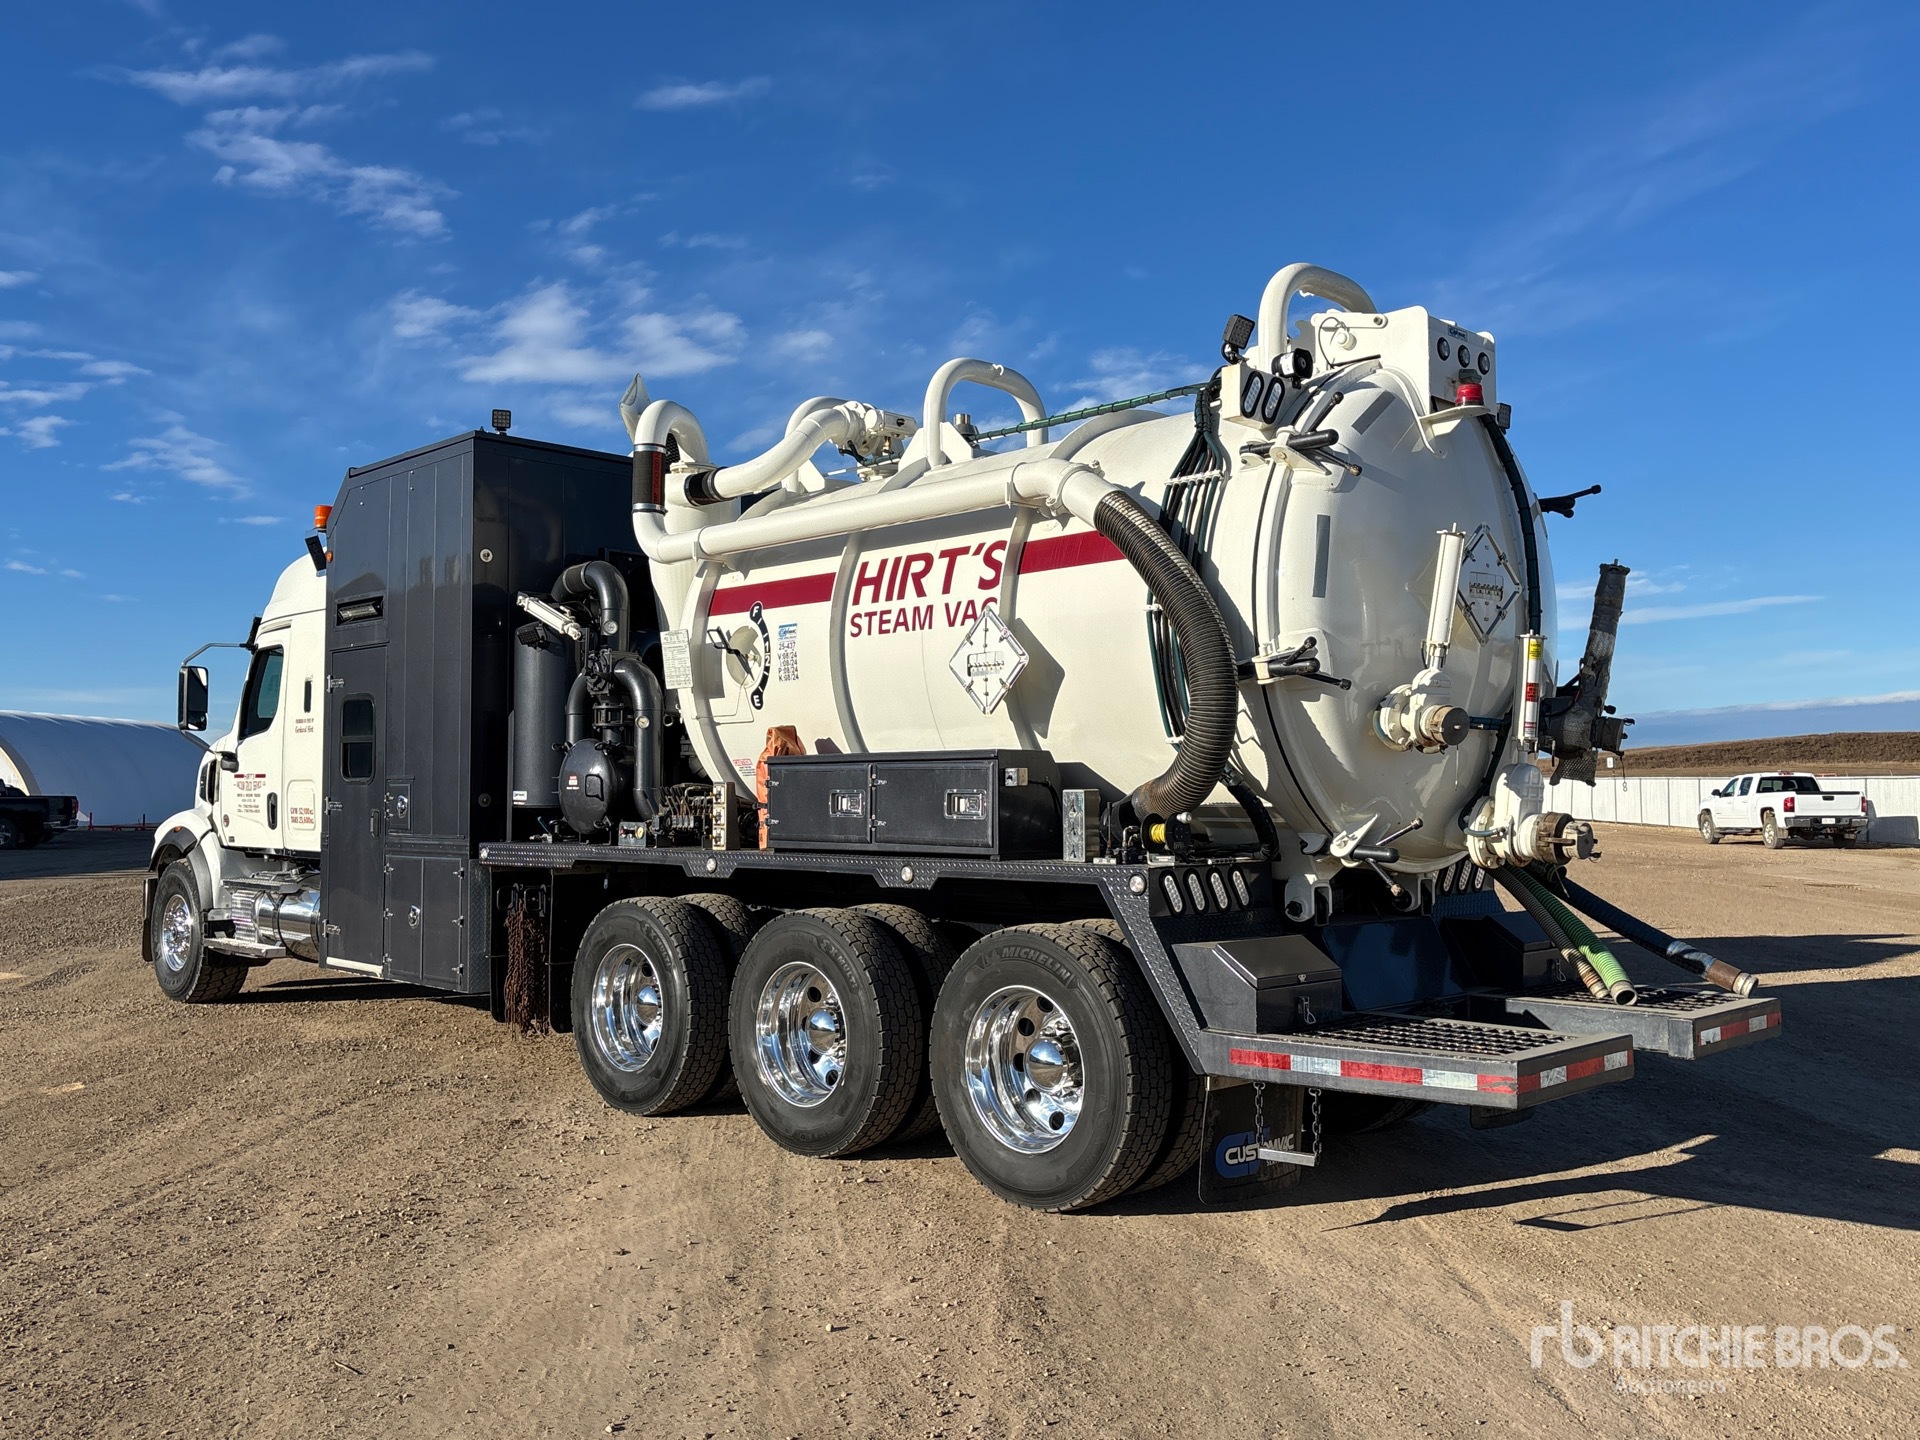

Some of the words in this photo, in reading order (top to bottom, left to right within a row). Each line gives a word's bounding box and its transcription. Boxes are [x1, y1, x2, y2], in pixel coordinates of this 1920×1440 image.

[852, 540, 1008, 606] HIRT'S
[752, 606, 760, 617] F
[850, 604, 934, 638] STEAM
[753, 695, 760, 707] E
[1002, 946, 1071, 980] MICHELIN
